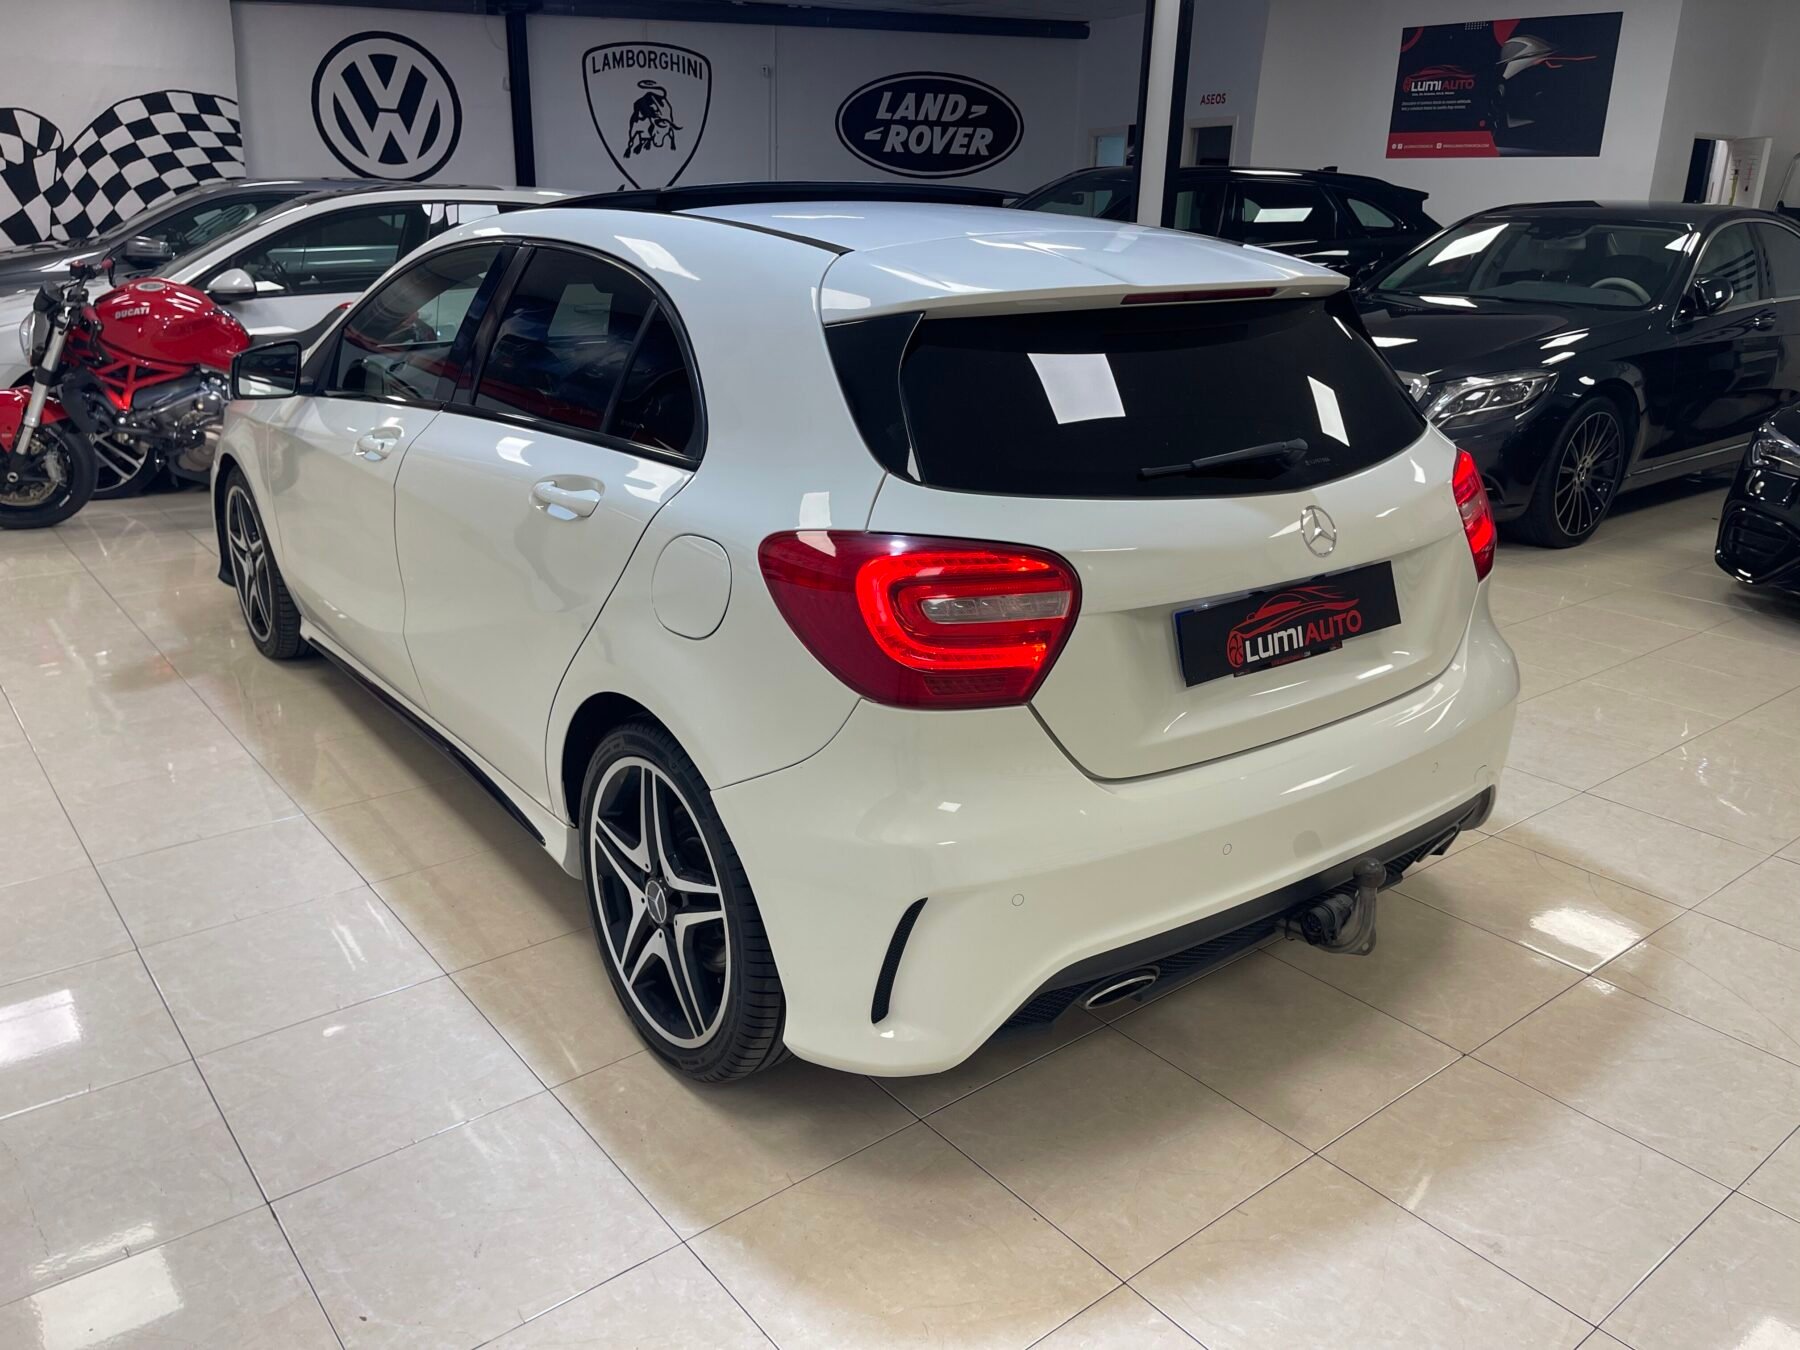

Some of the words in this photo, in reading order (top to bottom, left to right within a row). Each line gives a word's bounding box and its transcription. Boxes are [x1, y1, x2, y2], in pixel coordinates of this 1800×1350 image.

[591, 49, 703, 80] LAMBORGHINI
[875, 91, 967, 122] LAND
[1200, 92, 1227, 105] ASEOS
[882, 124, 994, 156] ROVER
[114, 306, 150, 320] DUCATI
